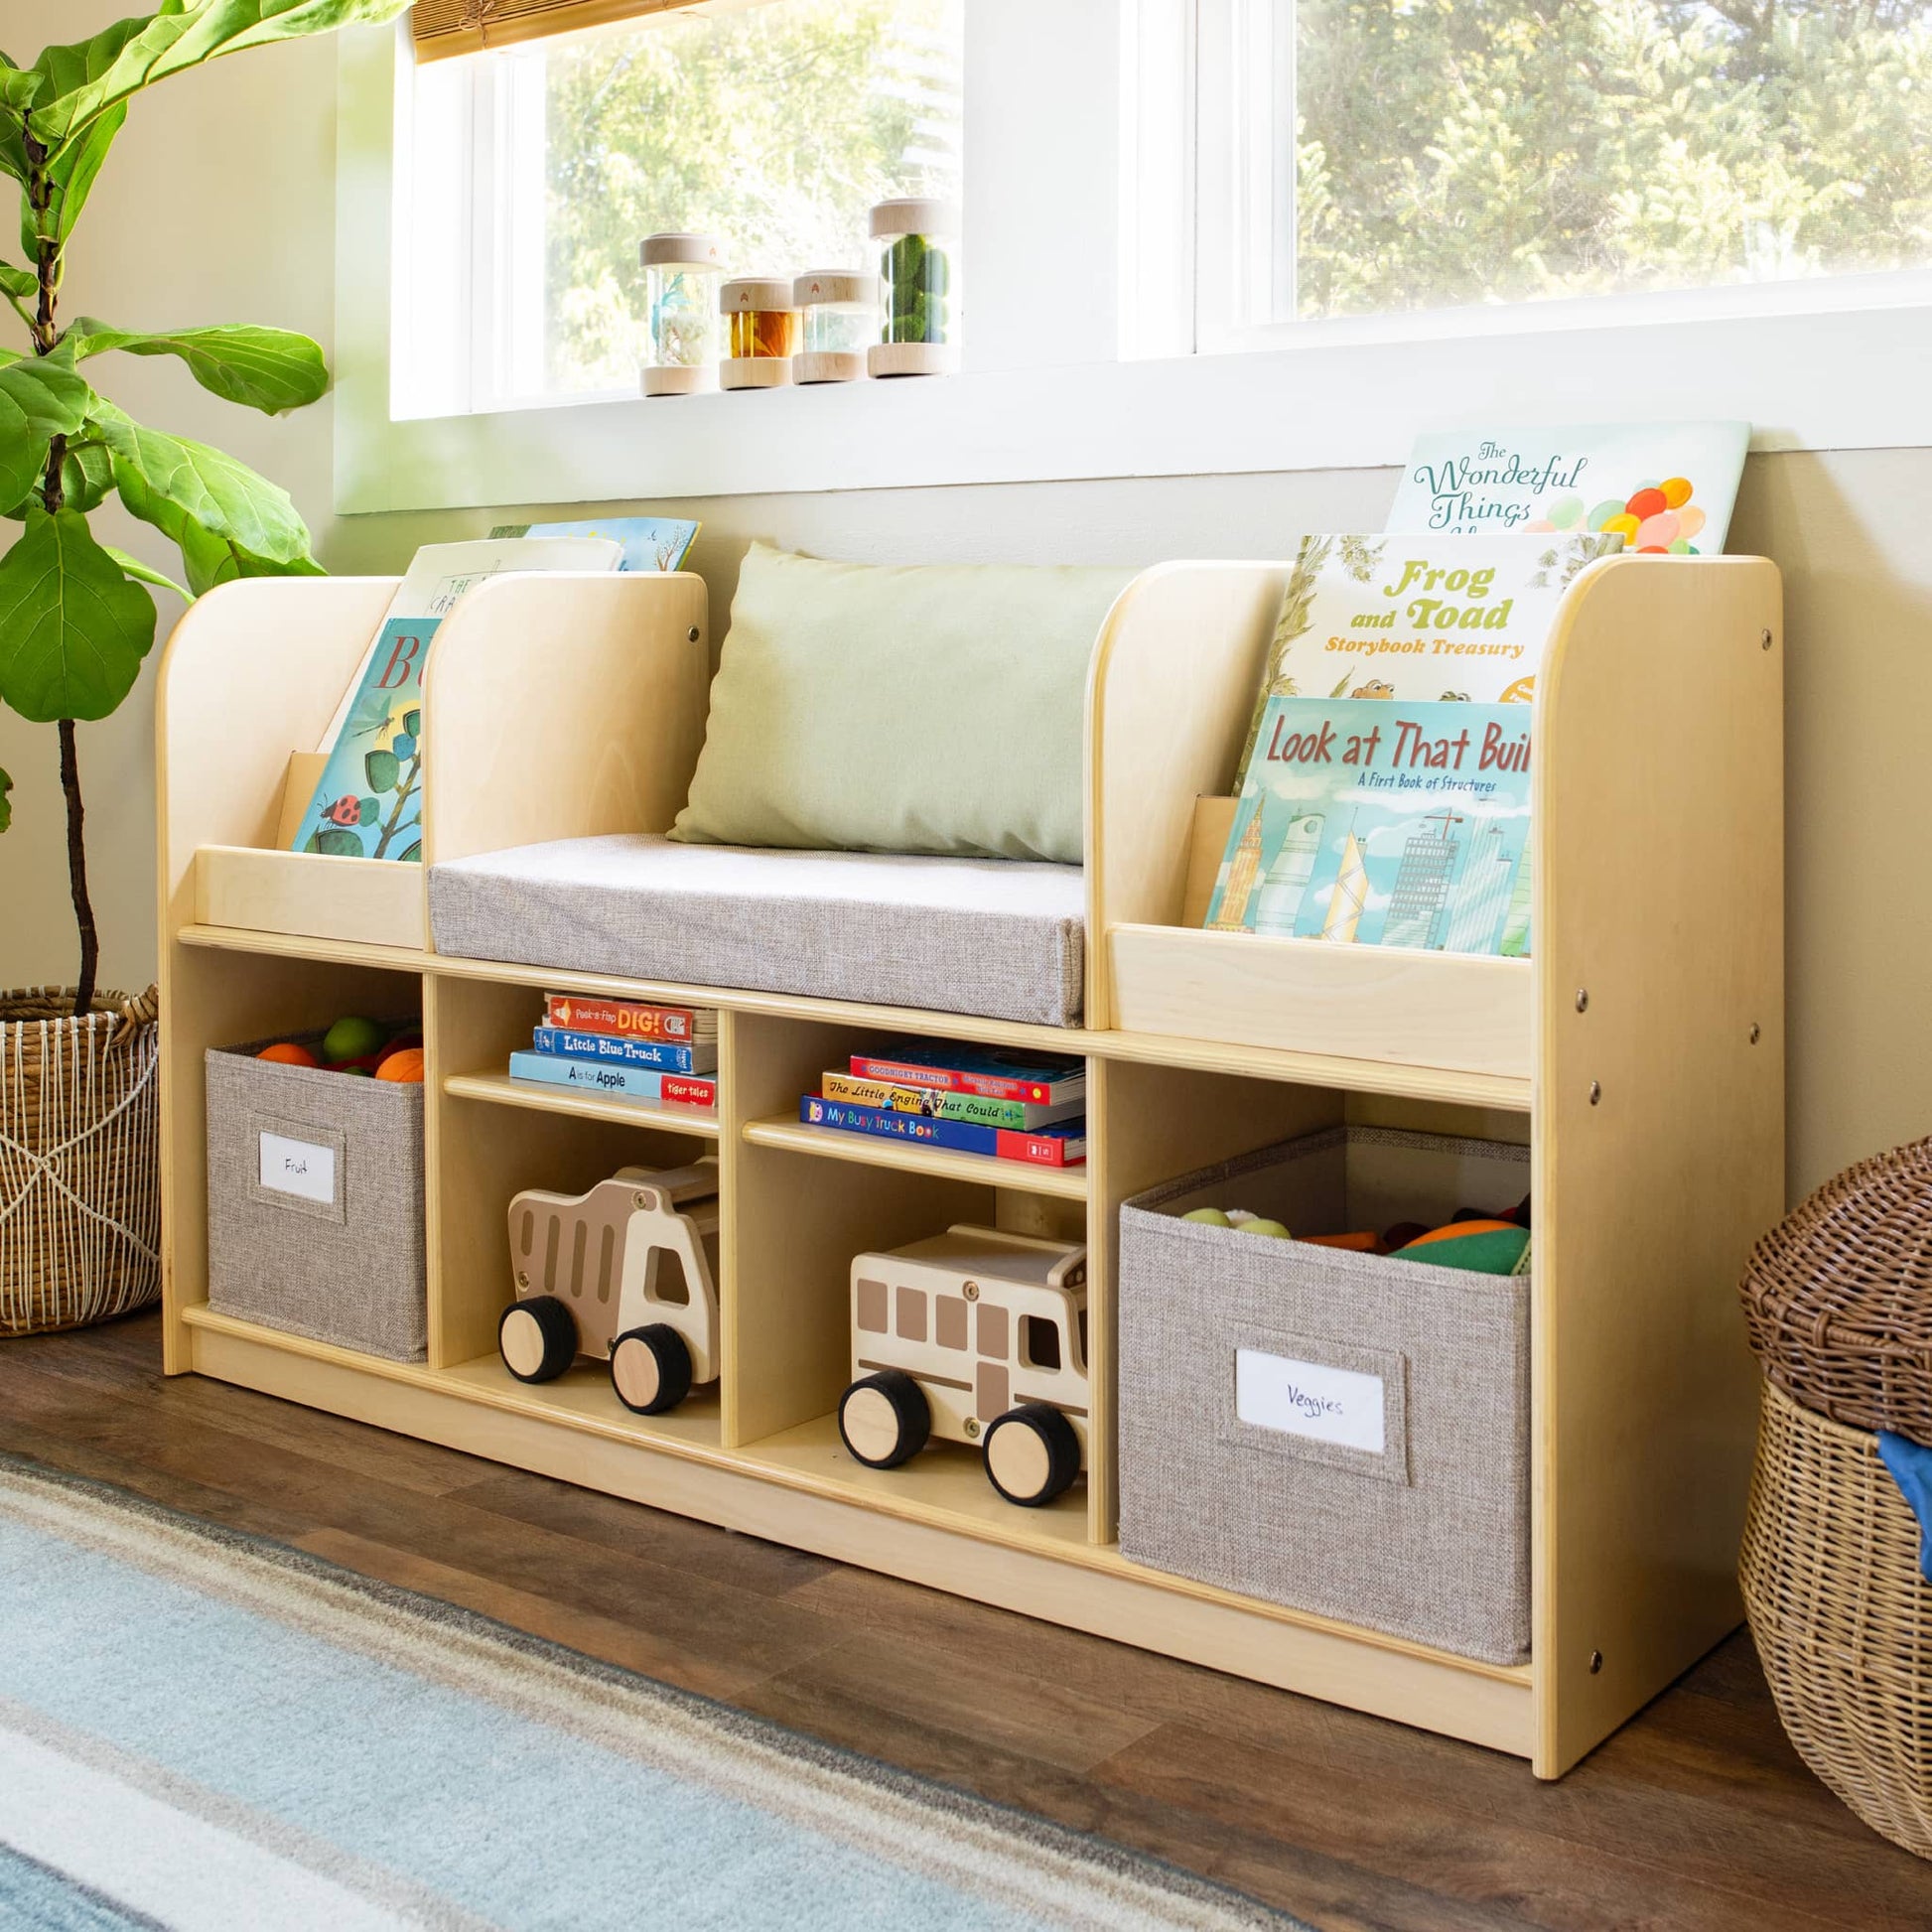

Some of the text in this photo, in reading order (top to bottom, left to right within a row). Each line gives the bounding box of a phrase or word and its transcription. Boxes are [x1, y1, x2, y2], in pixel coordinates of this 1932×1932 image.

[1477, 441, 1507, 461] The
[1414, 454, 1588, 494] Wonderful
[1429, 491, 1531, 529] Things
[1383, 560, 1496, 600] Frog
[1350, 598, 1514, 631] and Toad
[372, 635, 429, 689] B
[1324, 635, 1525, 659] Storybook Treasury
[1267, 714, 1338, 763] Look
[1342, 725, 1381, 766] at
[1392, 720, 1470, 771] That
[1357, 771, 1497, 792] A First Book of Structures
[617, 1008, 660, 1035] DIG!
[564, 1034, 597, 1052] Little
[599, 1038, 622, 1055] Blue
[623, 1042, 662, 1062] Truck
[569, 1065, 625, 1089] A is for Apple
[869, 1064, 913, 1080] GOODNIGHT
[914, 1071, 949, 1085] TRACTOR
[667, 1082, 709, 1098] tiger tales
[829, 1081, 1001, 1118] The Little Engine That Could
[827, 1107, 940, 1140] My Busy Truck Book
[285, 1158, 308, 1174] Fruit
[1287, 1383, 1344, 1418] Veggies
